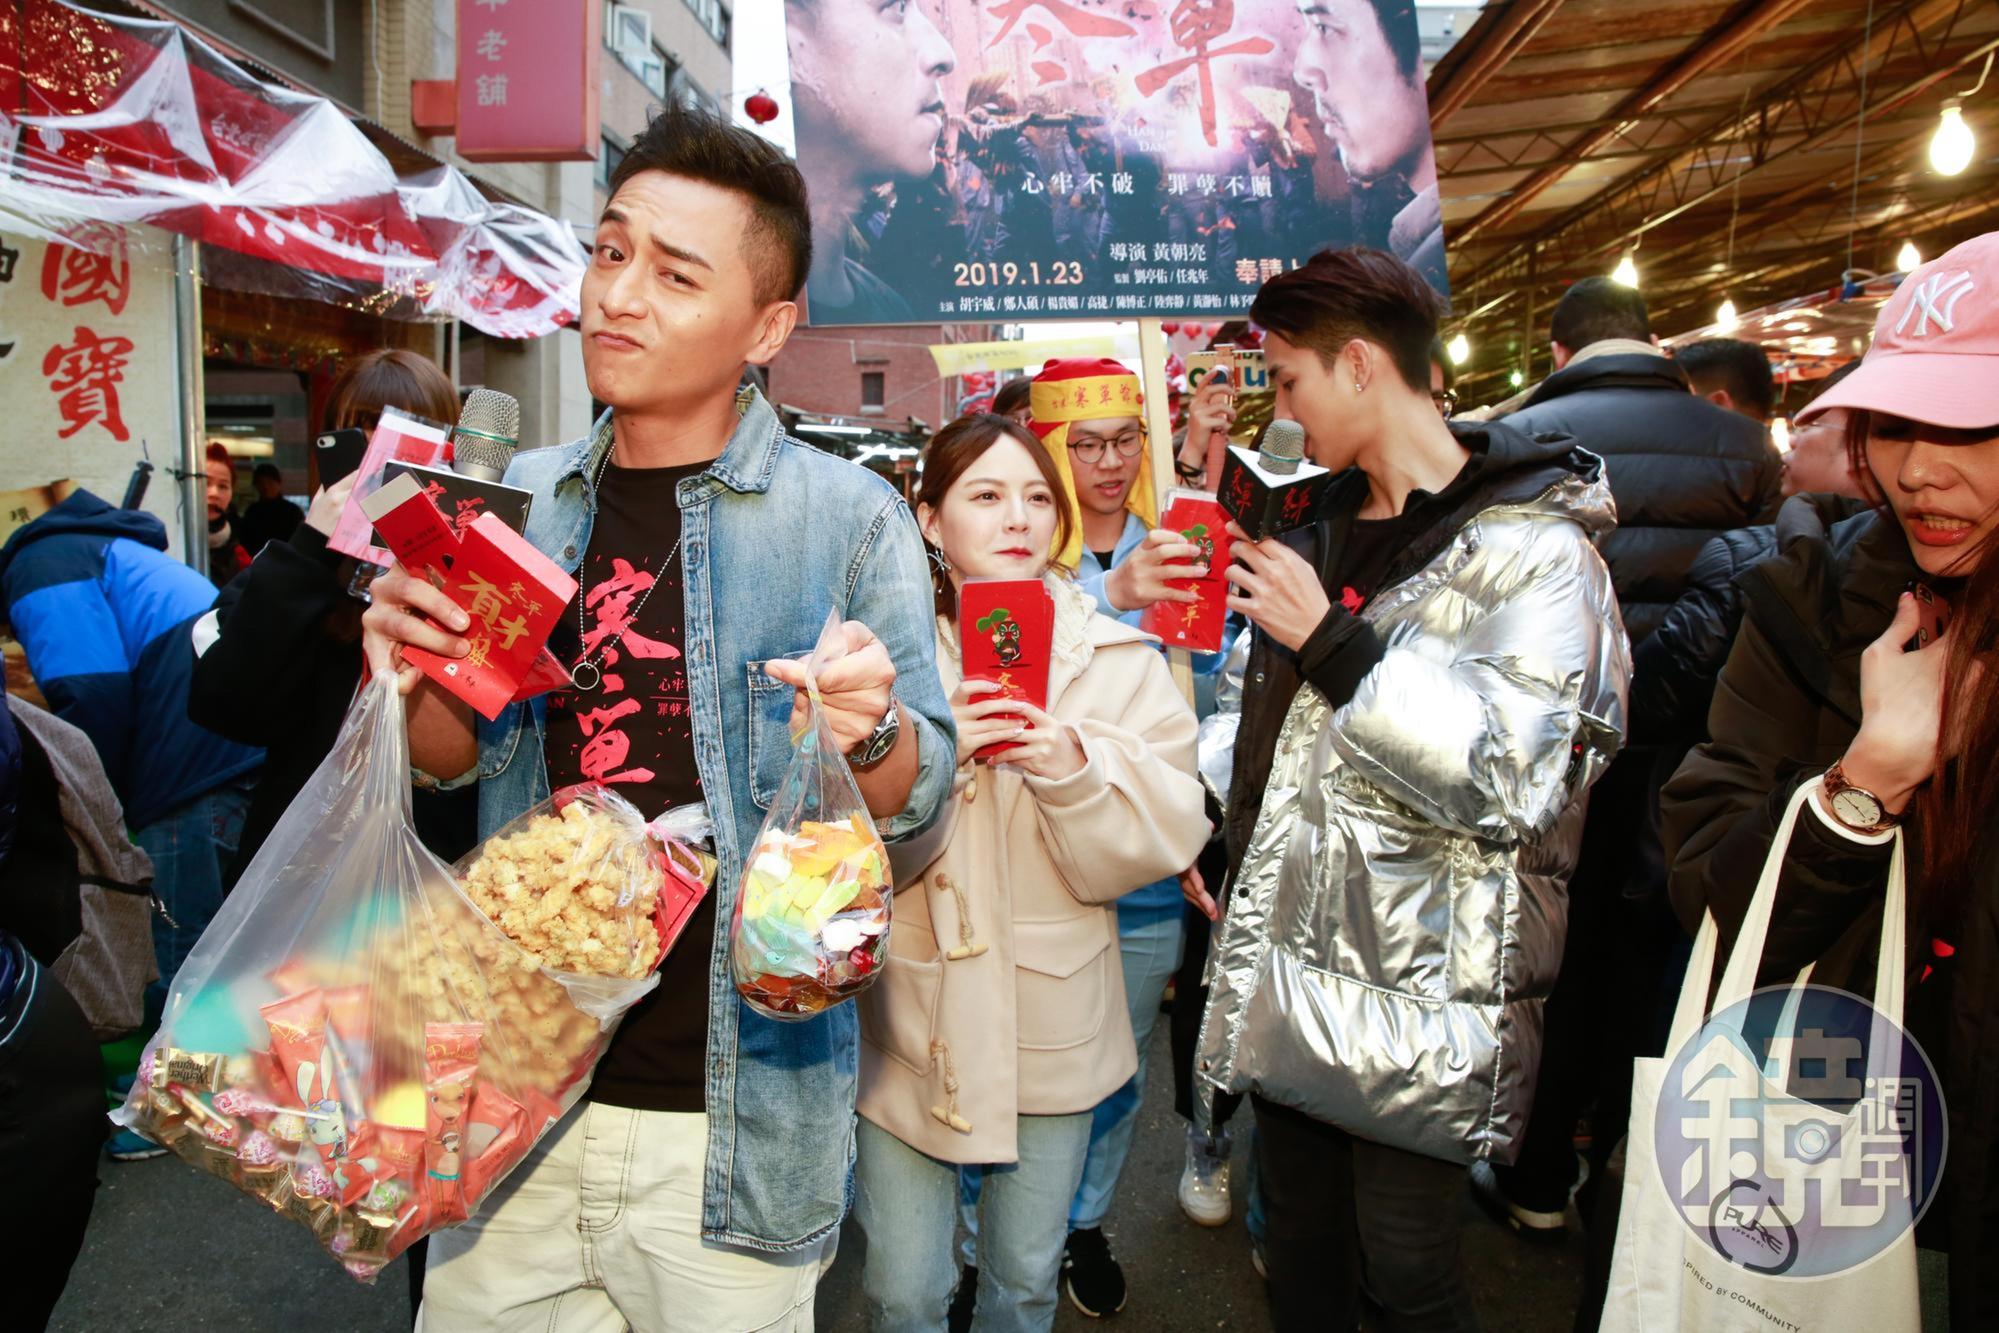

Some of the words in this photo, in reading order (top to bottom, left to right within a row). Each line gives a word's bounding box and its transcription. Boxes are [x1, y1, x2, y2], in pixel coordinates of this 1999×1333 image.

[476, 0, 508, 107] 老舖
[1021, 172, 1134, 194] 心牢不破
[1168, 173, 1272, 198] 罪孽不贖
[953, 261, 1084, 286] 2019.1.23
[1110, 243, 1147, 261] 導演
[1153, 243, 1206, 261] 黃朝亮
[41, 219, 134, 441] 國寶
[1723, 1206, 1784, 1255] PURE
[1716, 1287, 1728, 1296] BY
[1730, 1292, 1801, 1333] COMMUNITY
